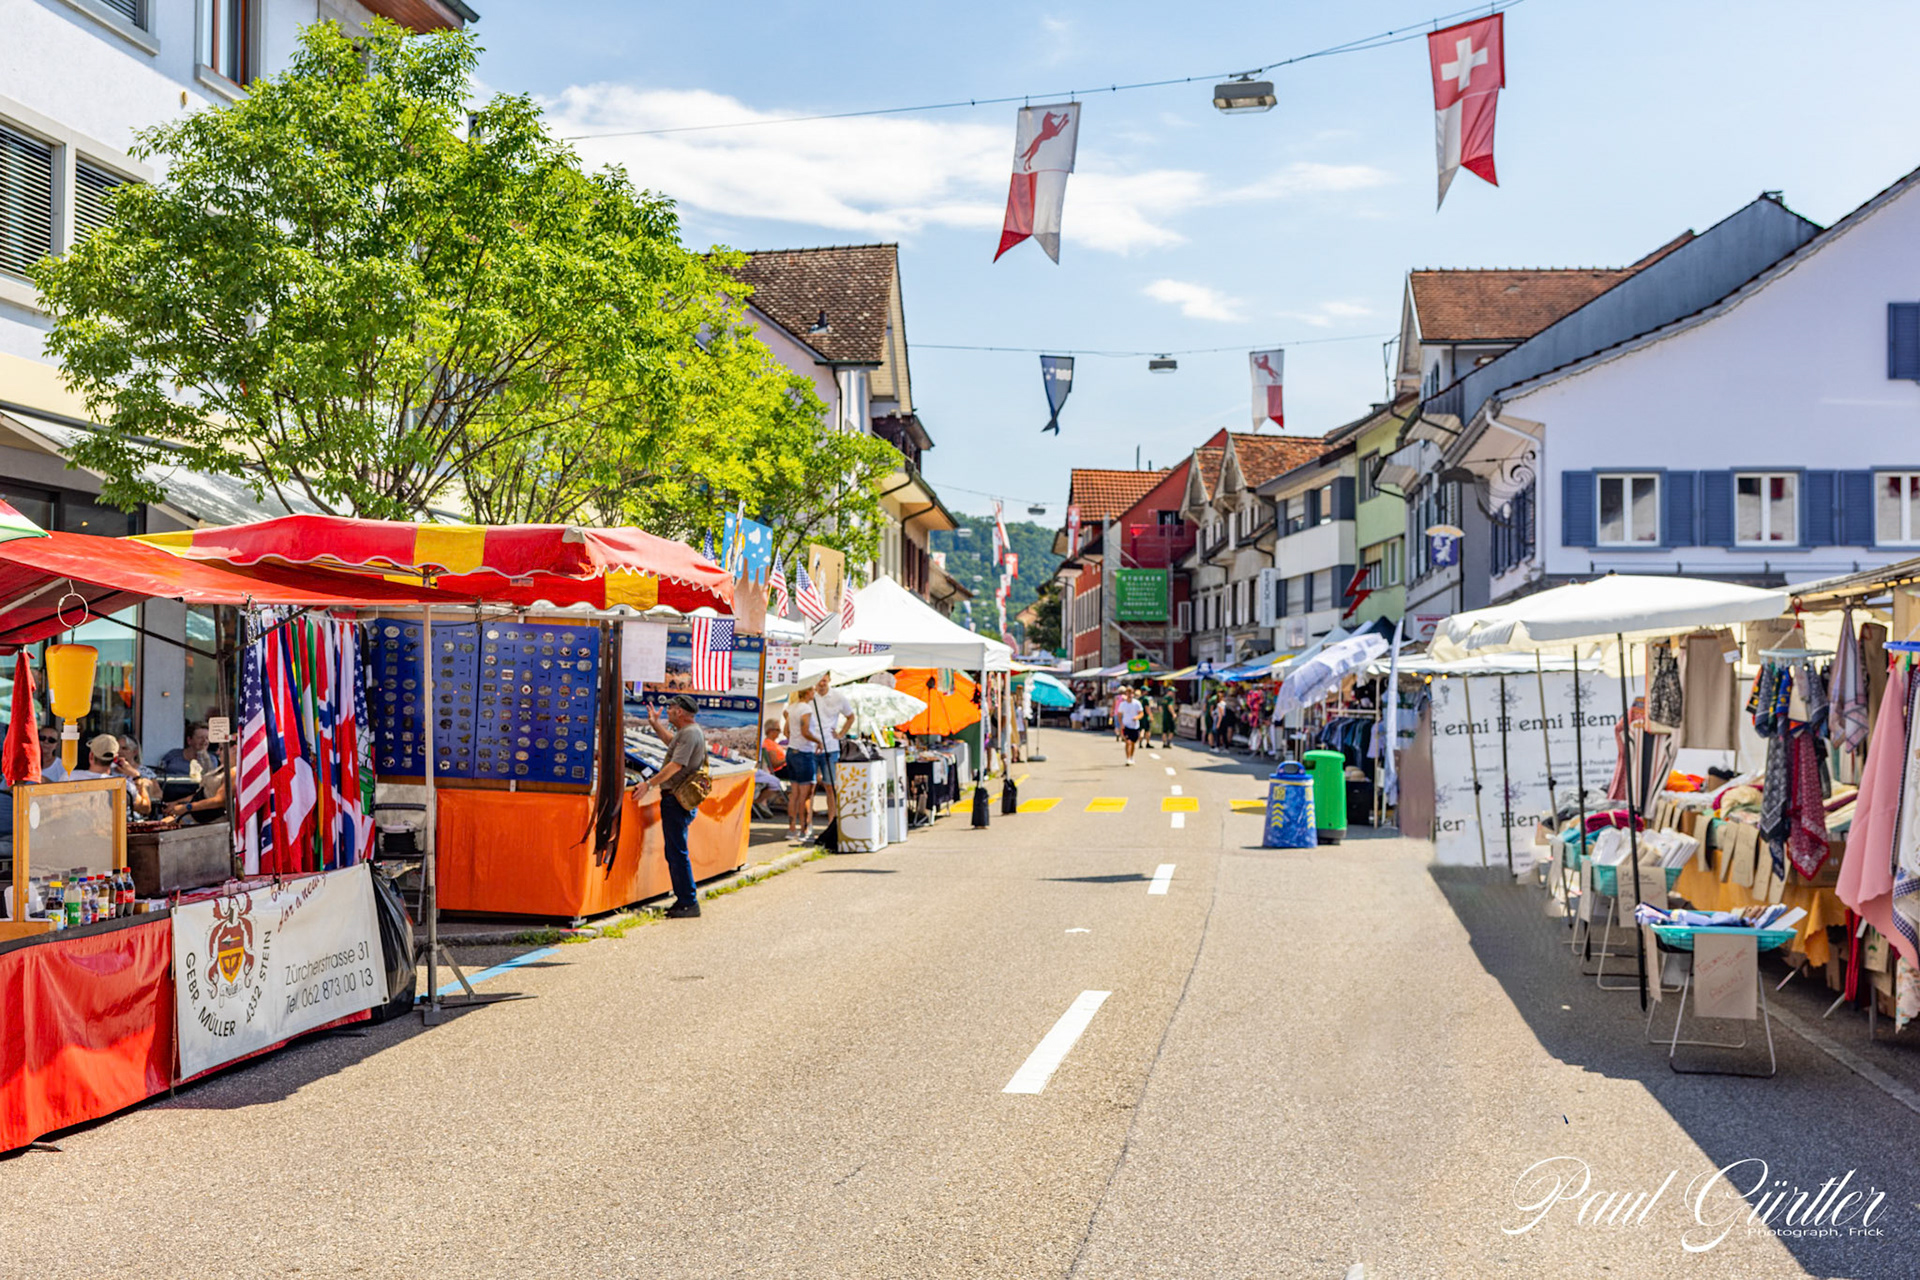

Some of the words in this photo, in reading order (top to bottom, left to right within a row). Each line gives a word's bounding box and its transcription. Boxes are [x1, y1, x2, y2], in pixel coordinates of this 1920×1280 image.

[198, 1005, 236, 1038] MÜLLER
[246, 985, 263, 1024] 4332
[259, 930, 272, 982] STEIN
[284, 948, 356, 986] Zürcherstrasse
[357, 940, 370, 961] 31
[301, 985, 321, 1008] 062
[322, 977, 342, 1000] 873
[343, 972, 356, 993] 00
[359, 967, 374, 987] 13
